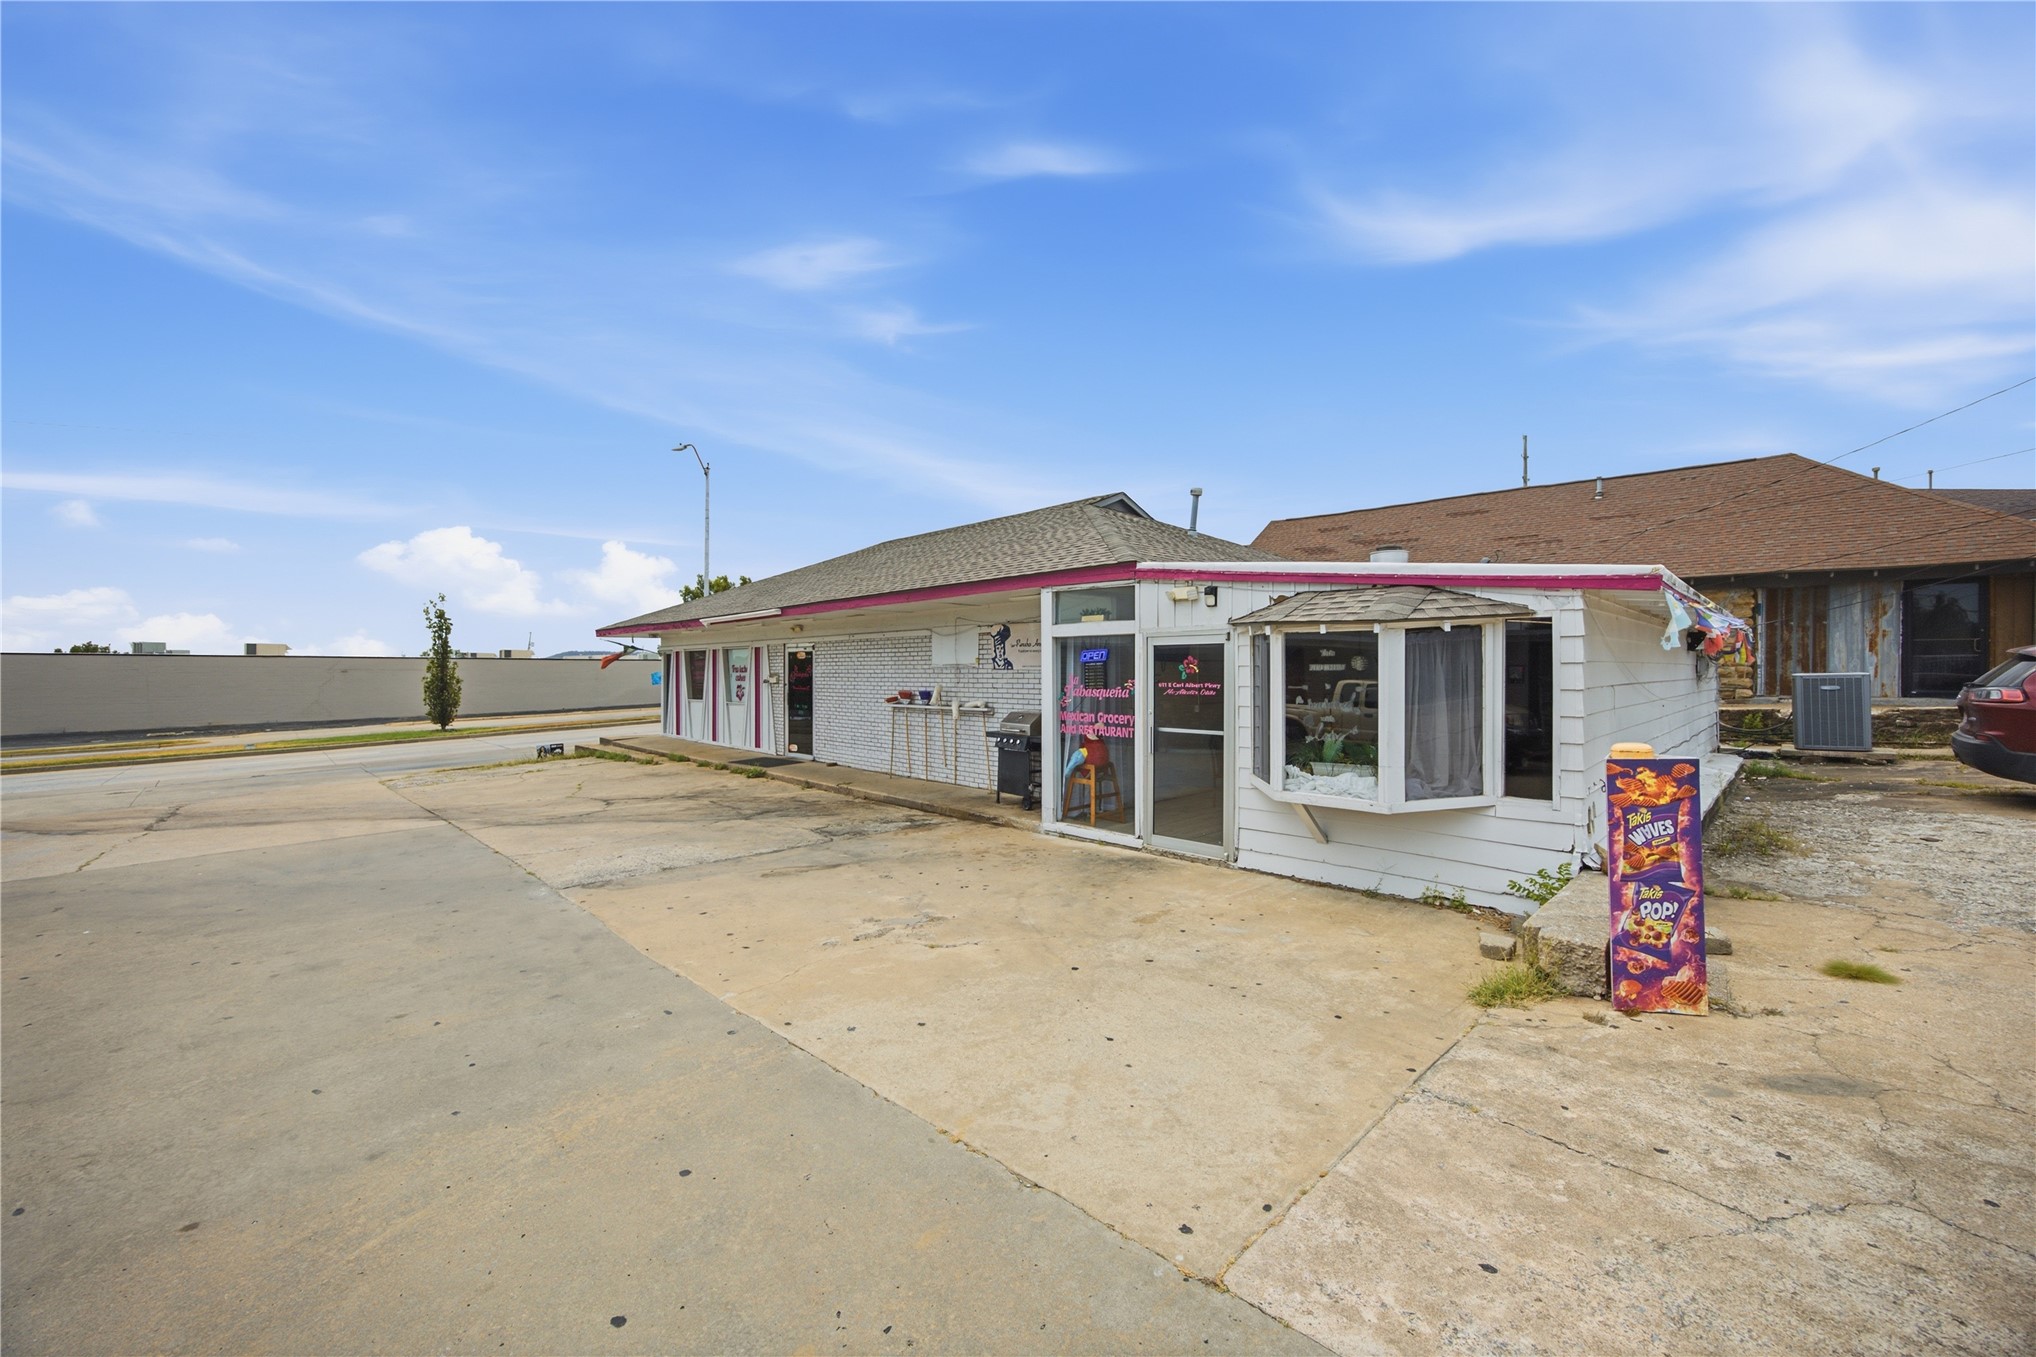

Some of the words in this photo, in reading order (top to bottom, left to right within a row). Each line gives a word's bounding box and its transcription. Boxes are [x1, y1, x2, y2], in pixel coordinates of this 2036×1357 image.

[1082, 651, 1106, 661] OPEN
[1068, 672, 1079, 685] La
[1064, 684, 1129, 700] Tabasqueña
[1060, 710, 1096, 723] Mexican
[1097, 712, 1135, 726] Grocery
[1060, 723, 1077, 734] And
[1078, 724, 1134, 739] RESTAURANT
[1627, 812, 1652, 829] Takis
[1628, 819, 1674, 846] WAVES
[1639, 887, 1664, 899] Takis
[1640, 901, 1679, 920] POP!
